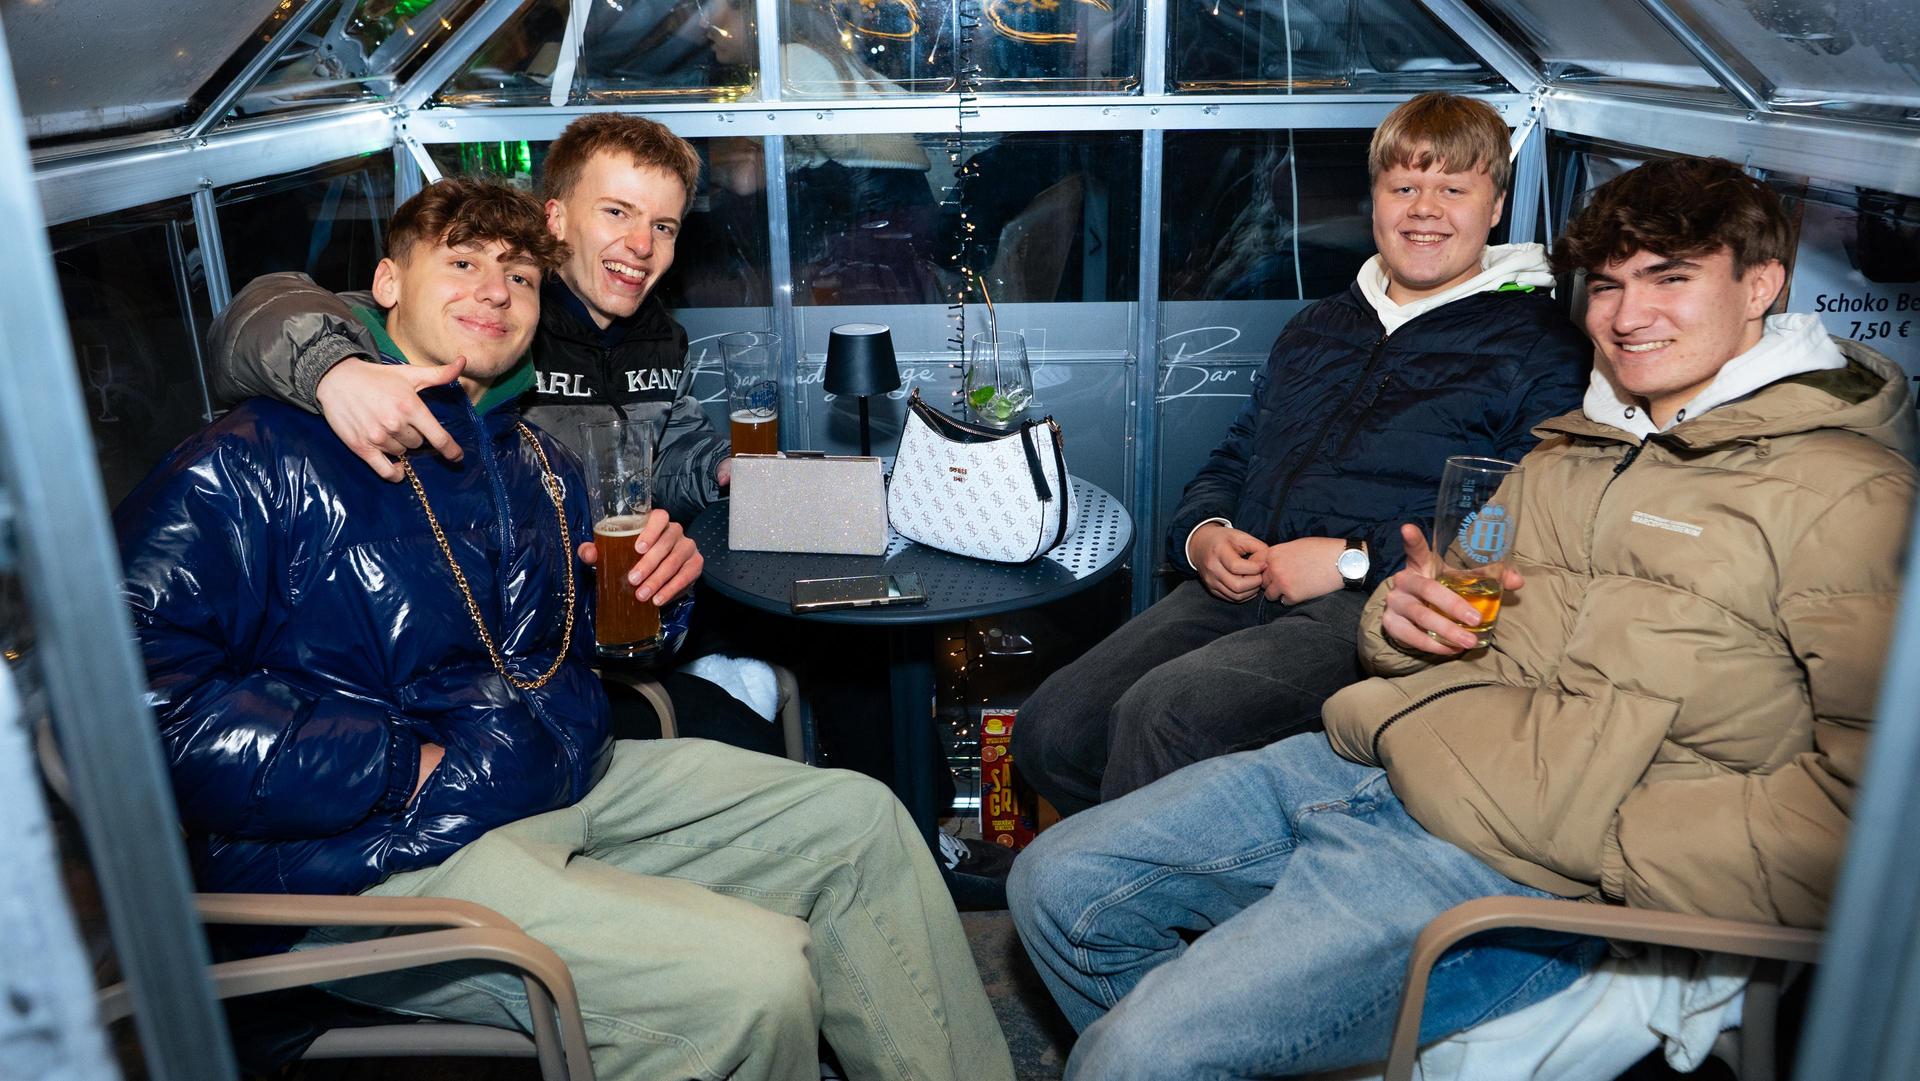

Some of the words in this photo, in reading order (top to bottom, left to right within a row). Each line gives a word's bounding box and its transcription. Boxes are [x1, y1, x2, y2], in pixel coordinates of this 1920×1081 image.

[1815, 292, 1889, 313] Schoko
[1896, 293, 1920, 312] Be
[1849, 321, 1891, 342] 7,50
[1897, 320, 1911, 338] €
[1156, 326, 1241, 404] Bar
[535, 370, 592, 397] ARL
